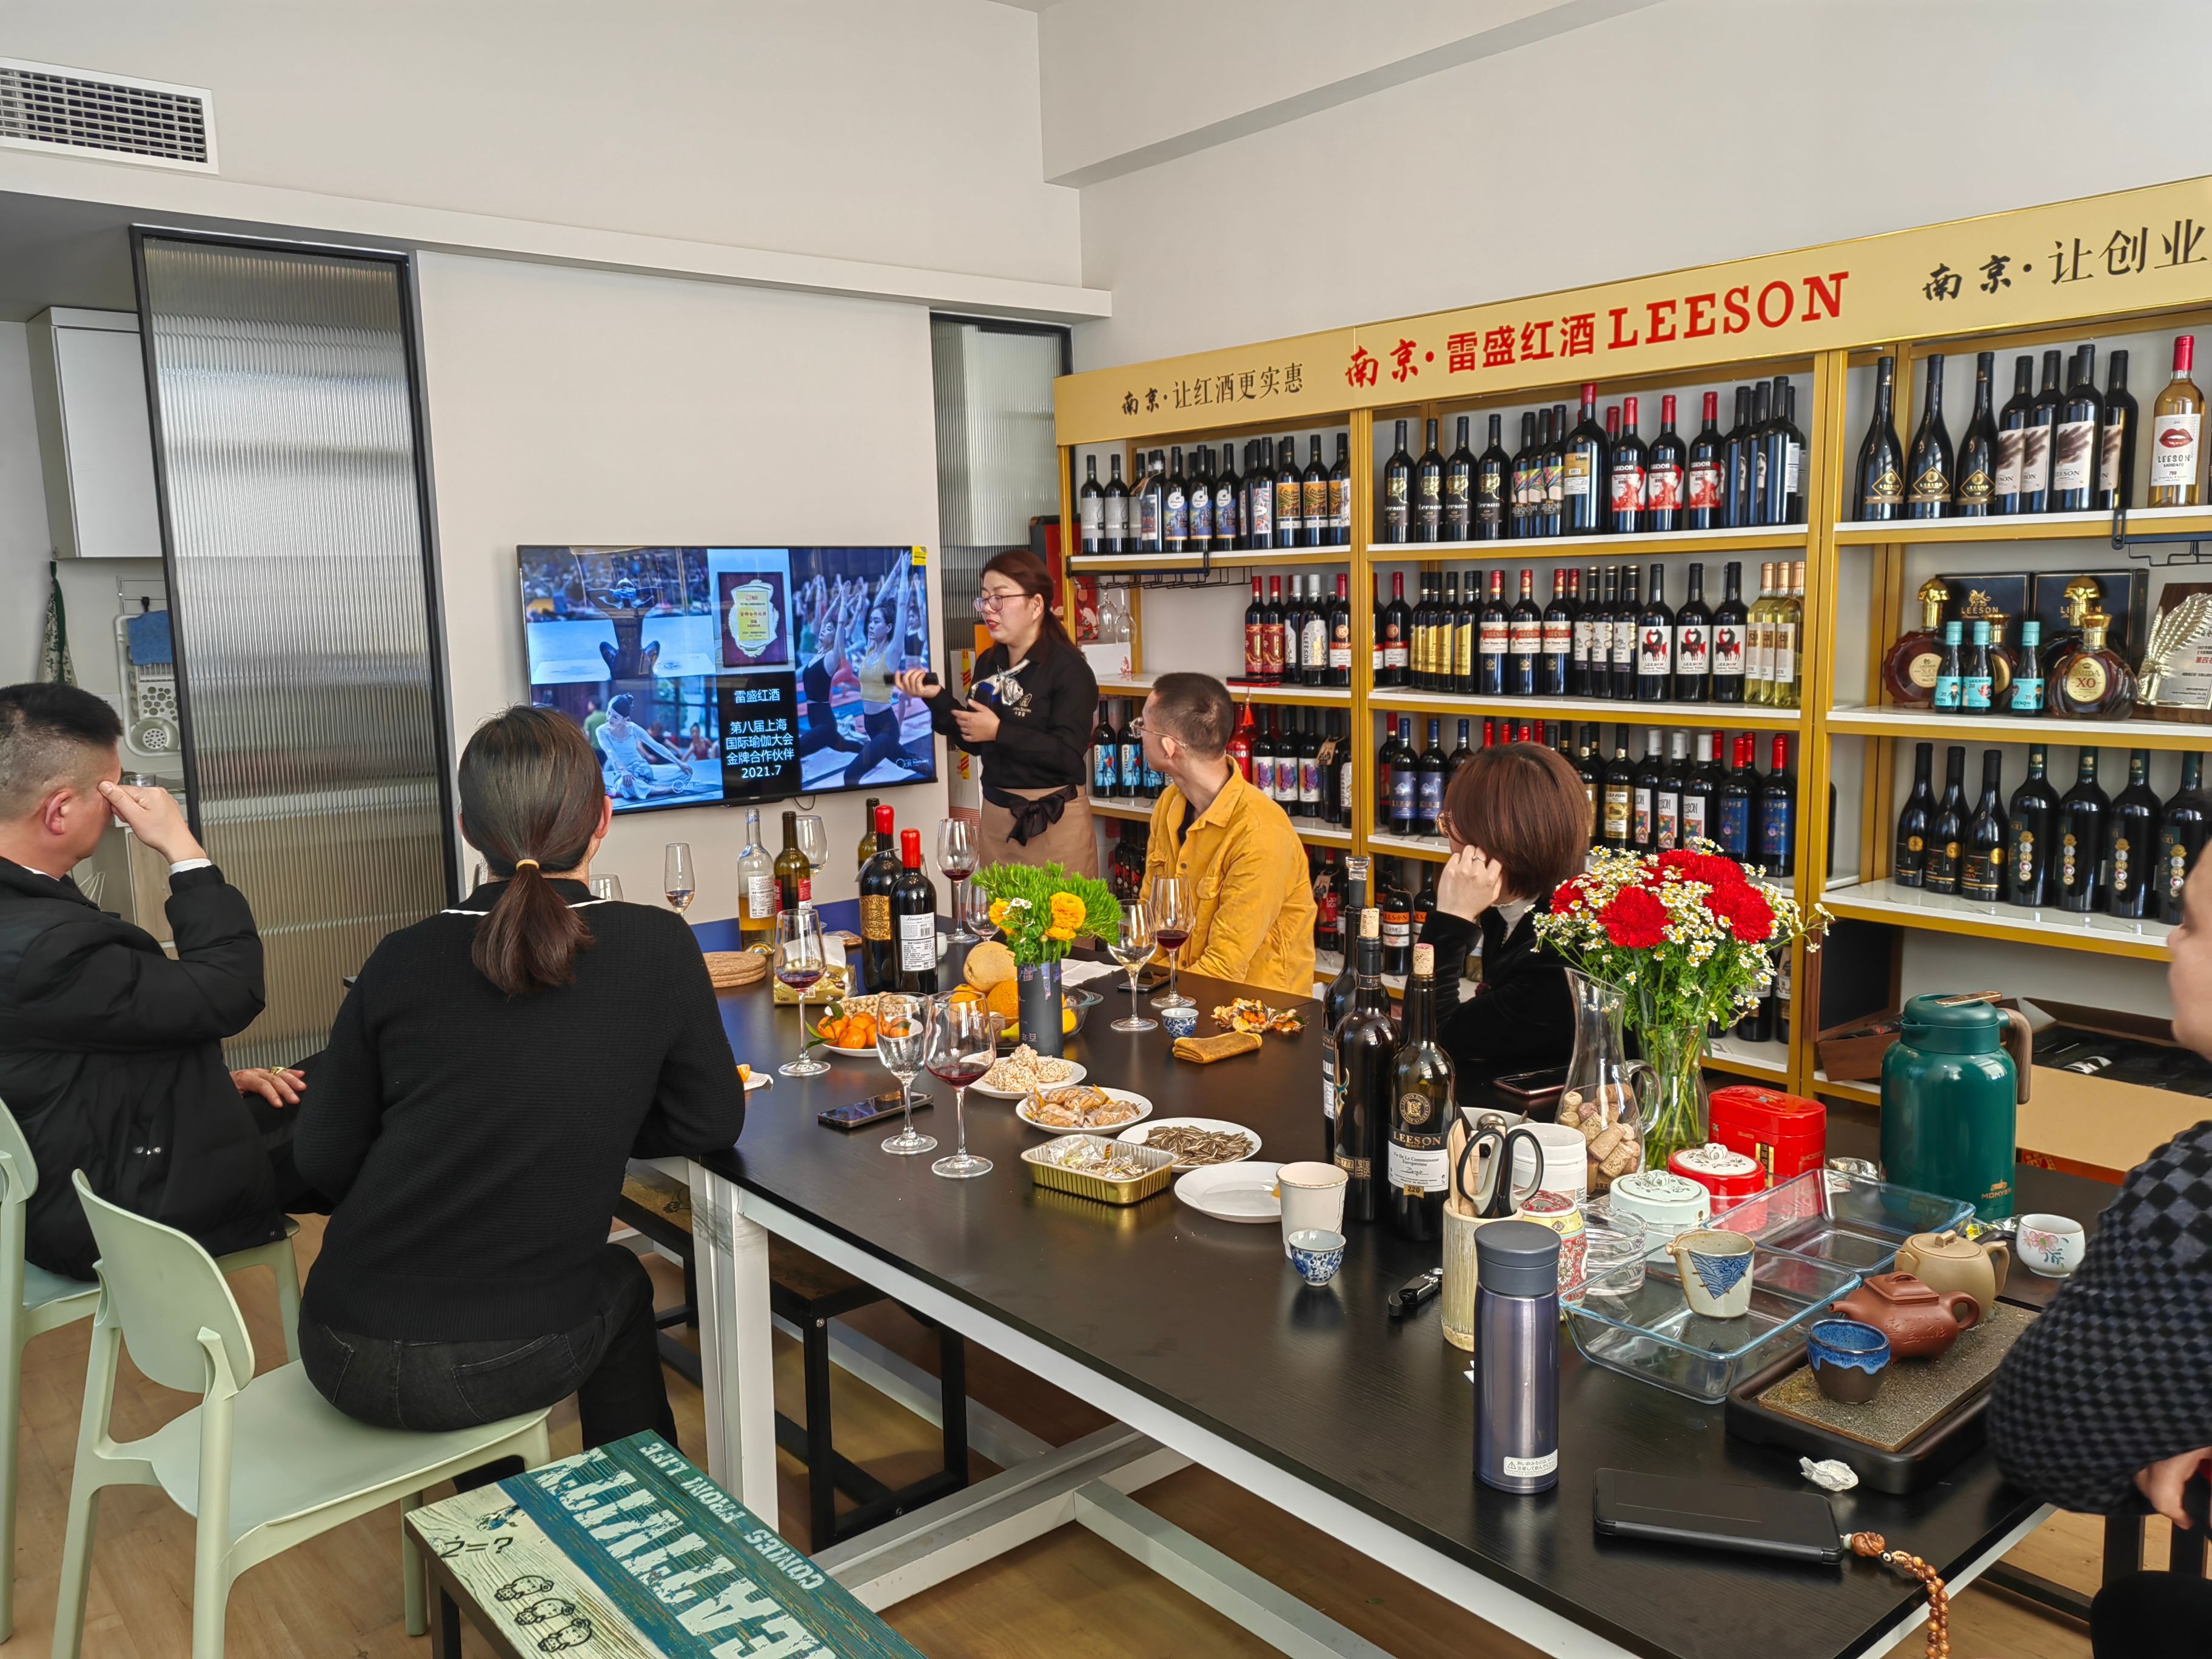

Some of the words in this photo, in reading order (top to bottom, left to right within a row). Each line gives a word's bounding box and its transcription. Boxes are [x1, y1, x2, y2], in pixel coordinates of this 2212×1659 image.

[1922, 218, 2212, 301] 南京·让创业
[1344, 312, 1596, 389] 南京·雷盛红酒
[1607, 271, 1849, 350] LEESON
[1121, 362, 1304, 417] 南京·让红酒更实惠
[2158, 454, 2190, 463] LEESON
[2076, 677, 2096, 688] XO
[734, 688, 780, 703] 雷盛红酒
[729, 718, 788, 735] 第八届上海
[726, 733, 794, 751] 国际瑜伽大会
[726, 748, 795, 766] 金牌合作伙伴
[742, 765, 782, 779] 2021.7
[1393, 1131, 1441, 1146] LEESON
[1342, 1158, 1353, 1167] 777
[638, 1442, 690, 1476] LIFE
[680, 1476, 746, 1524] FROM
[535, 1447, 837, 1659] EATIVITY
[743, 1528, 826, 1590] COMES
